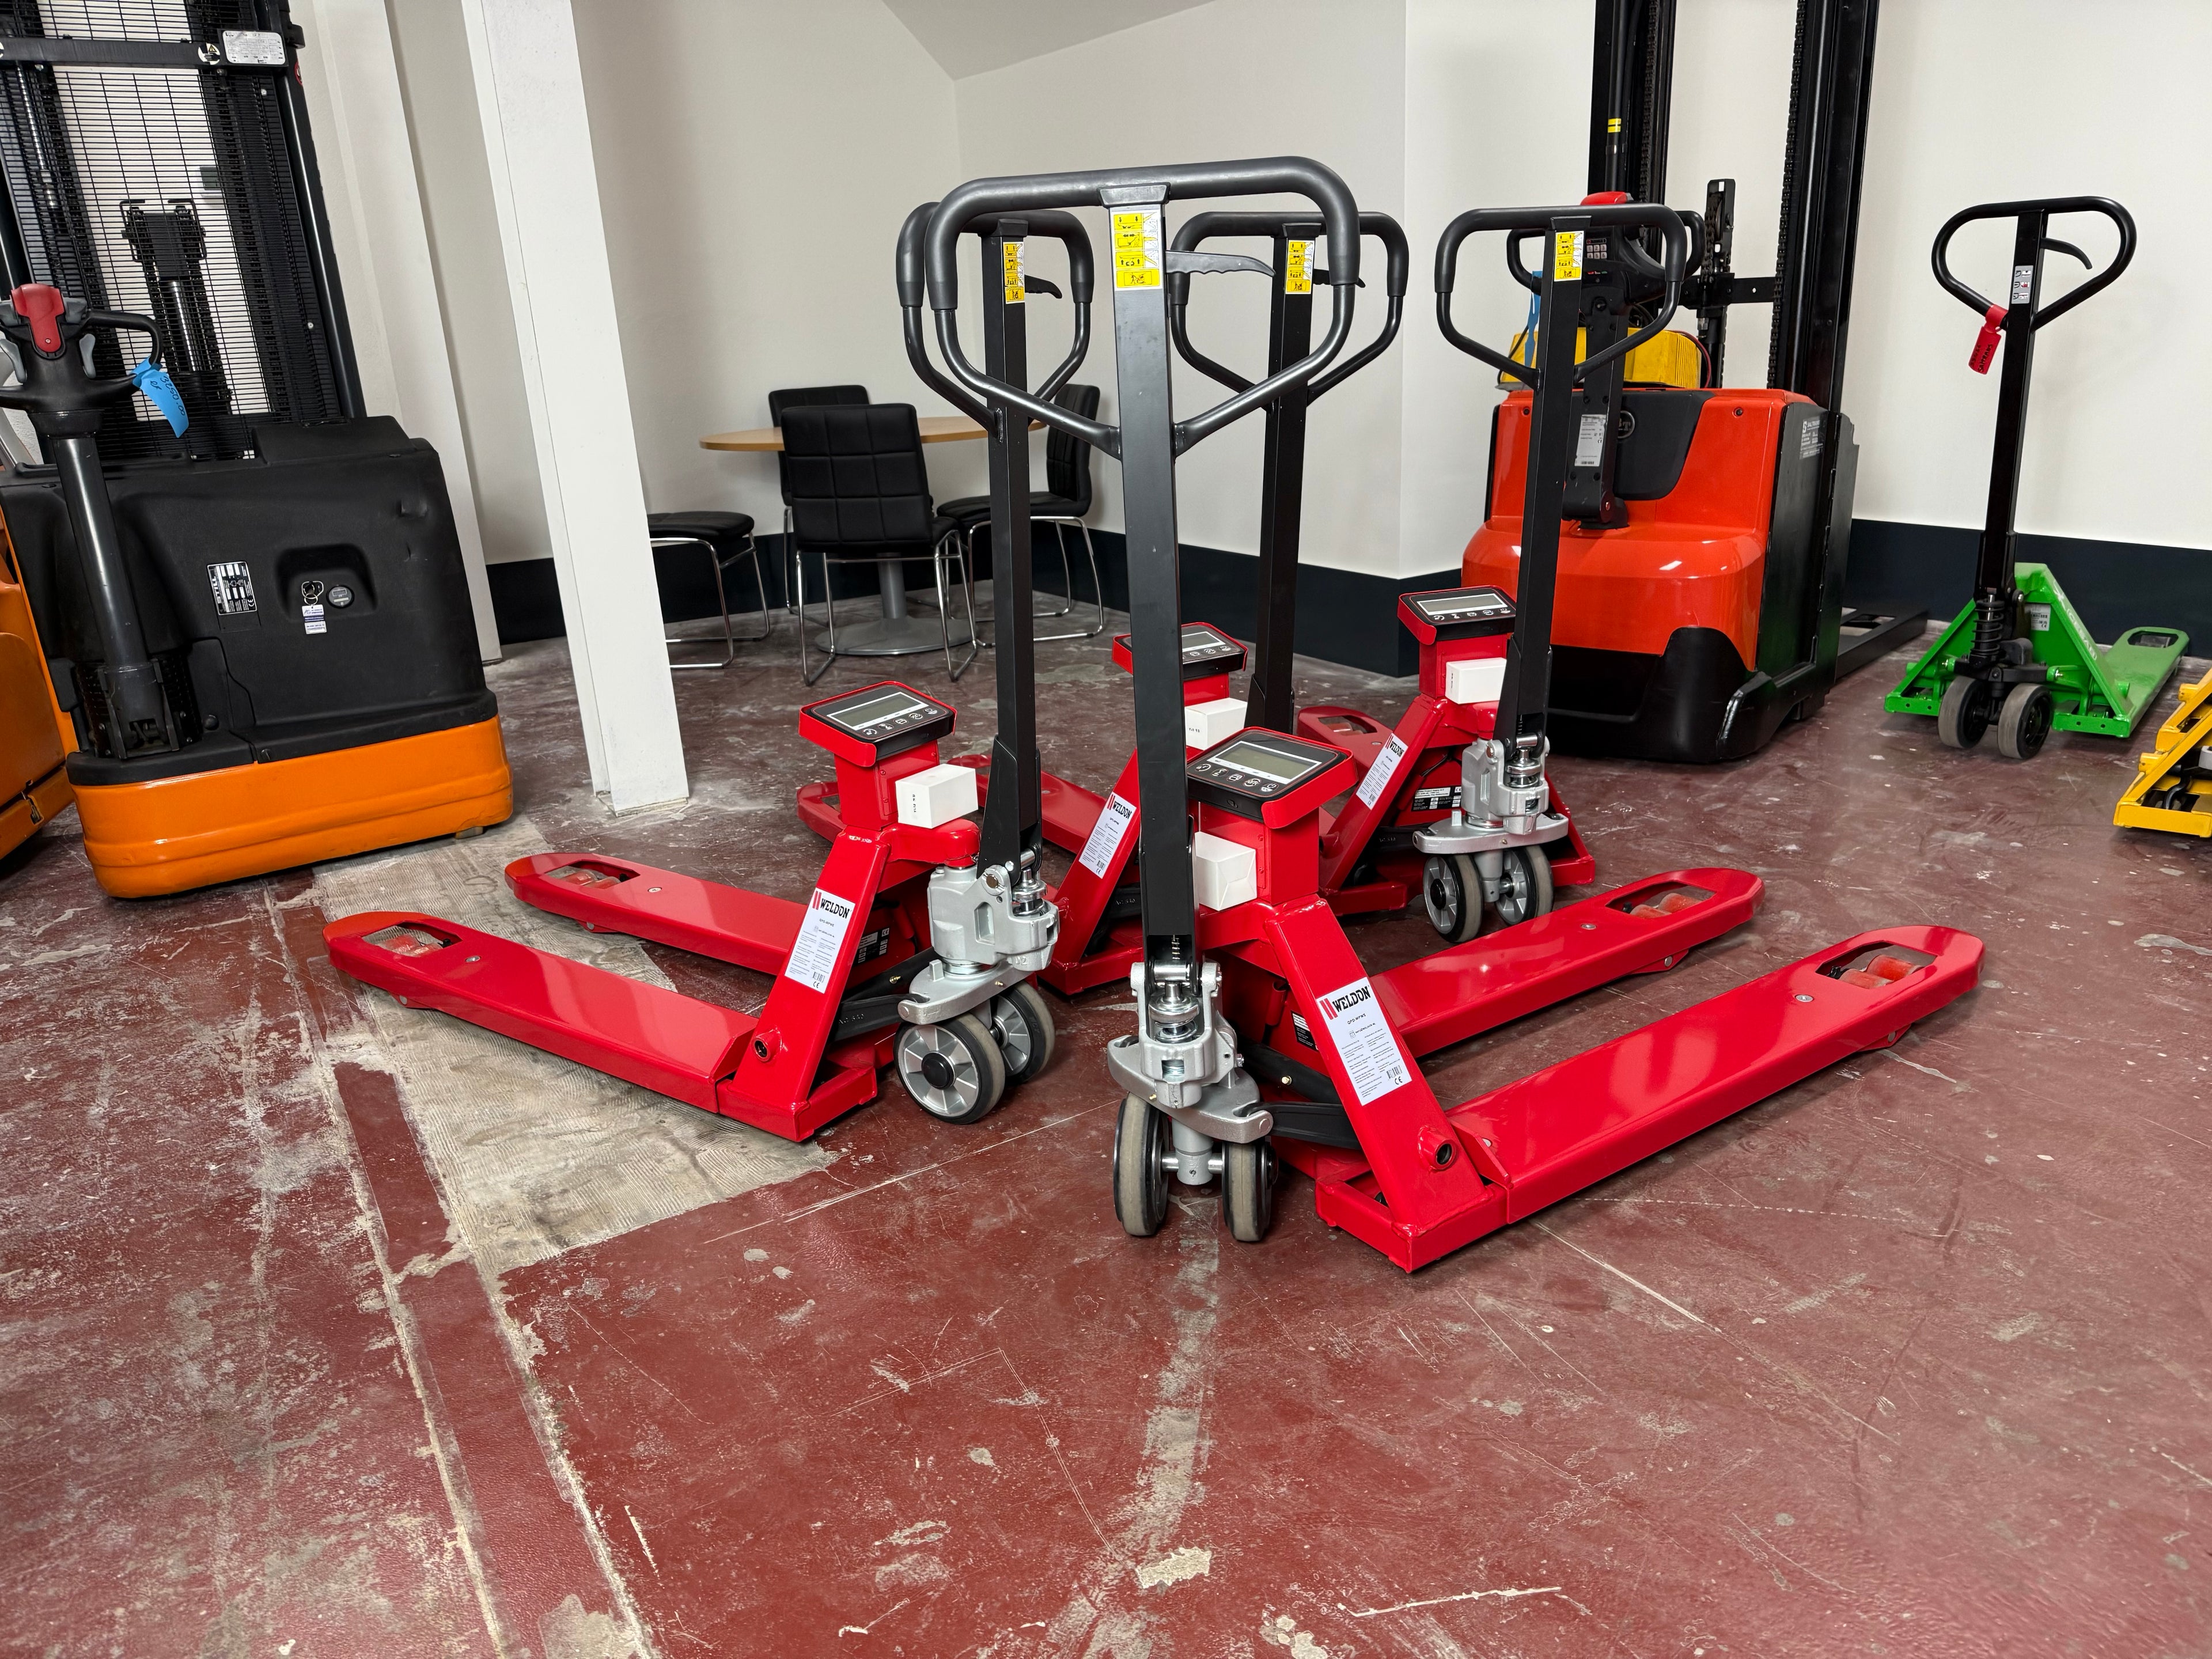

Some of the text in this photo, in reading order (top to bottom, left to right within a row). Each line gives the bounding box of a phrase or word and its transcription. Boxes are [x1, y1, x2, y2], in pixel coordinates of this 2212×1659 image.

[1112, 801, 1132, 819] WELDON
[820, 898, 850, 919] WELDON
[1332, 986, 1371, 1013] WELDON
[1395, 1076, 1403, 1085] CE
